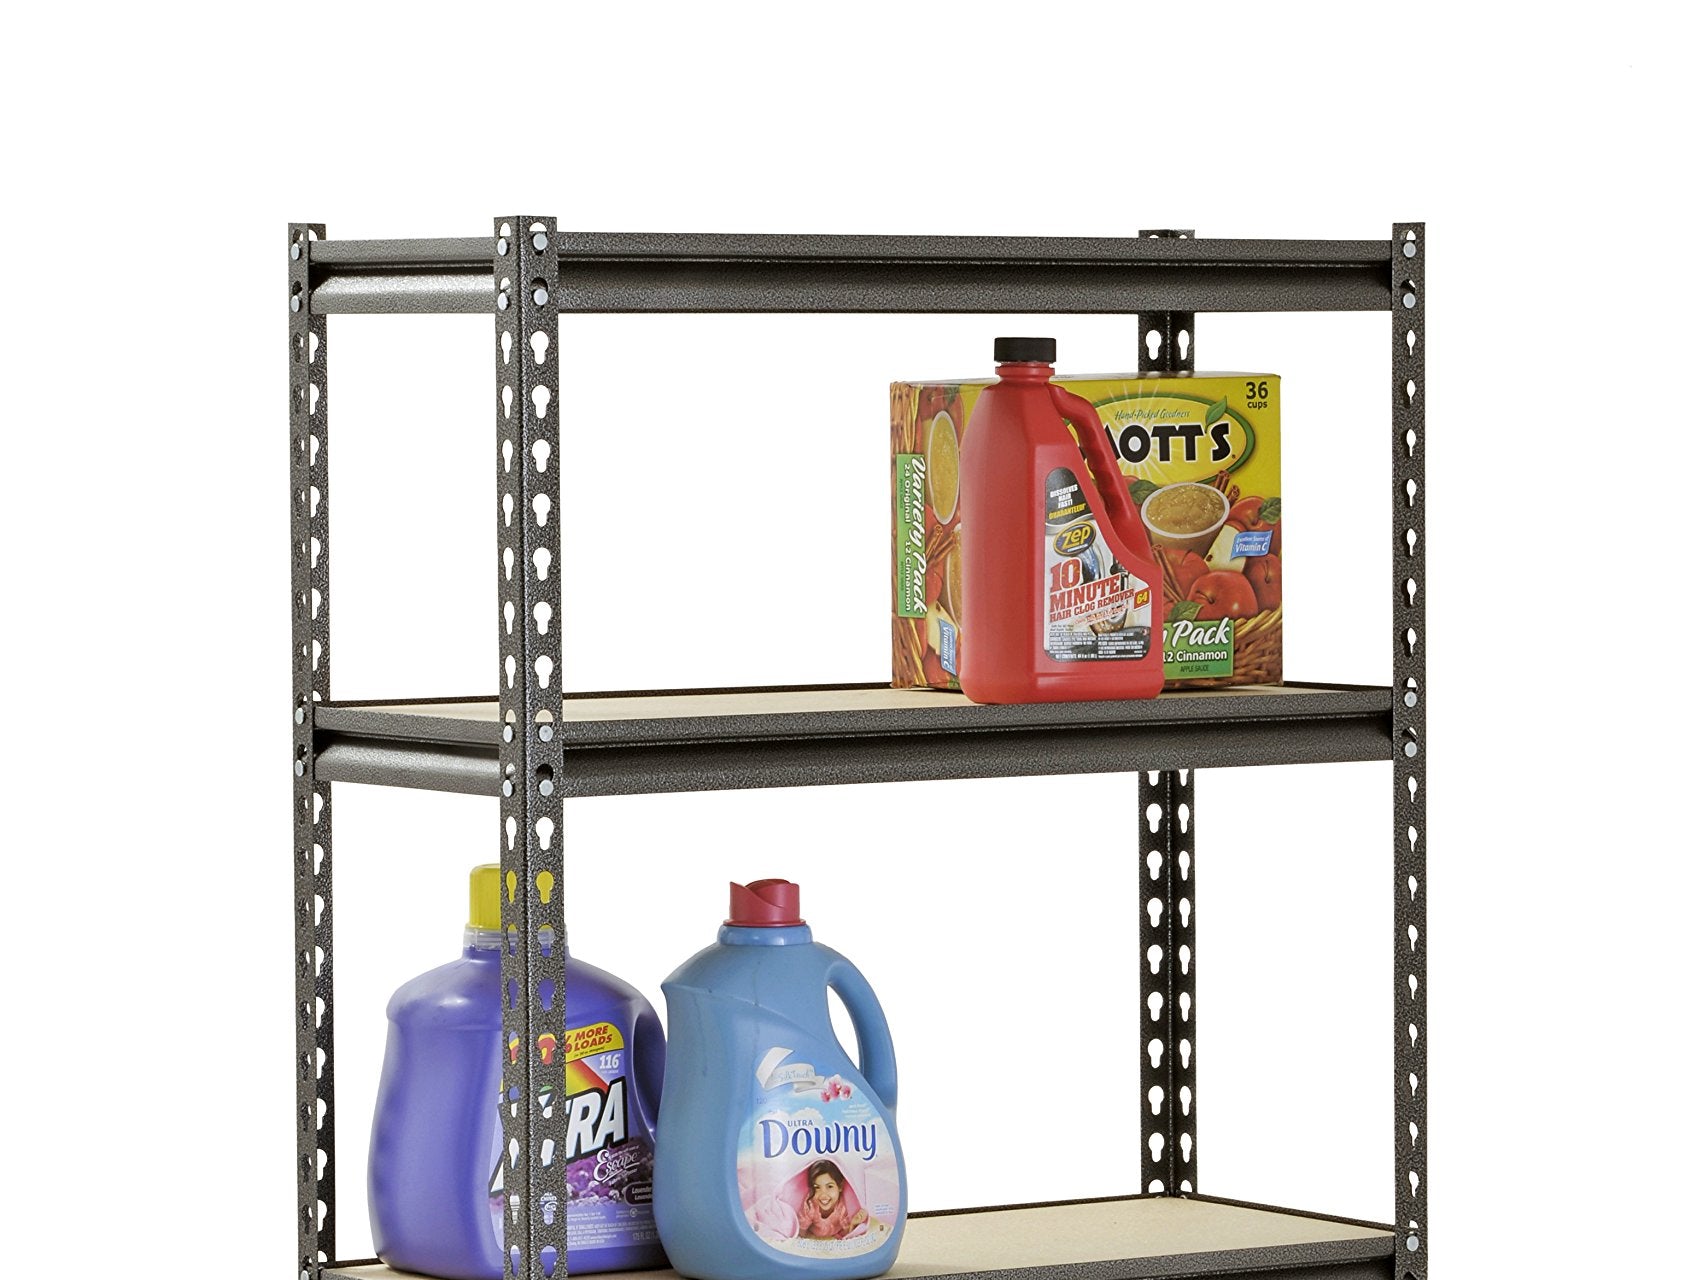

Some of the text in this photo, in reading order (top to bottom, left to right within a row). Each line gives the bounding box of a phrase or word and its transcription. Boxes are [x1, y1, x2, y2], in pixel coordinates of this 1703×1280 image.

[1245, 381, 1269, 400] 36
[1247, 401, 1268, 410] cups
[1115, 408, 1191, 420] Hand-Picked Goodness
[1104, 422, 1232, 463] OTT'S
[904, 464, 911, 477] 24
[911, 457, 928, 614] Variety Pack
[905, 541, 911, 554] 12
[1235, 541, 1267, 553] Vitamin C
[1050, 558, 1082, 593] 10
[1050, 574, 1120, 613] MINUTE
[1136, 592, 1148, 605] 64
[1050, 609, 1072, 622] HAIR
[1074, 601, 1096, 616] CLOG
[1097, 588, 1135, 608] REMOVER
[1172, 617, 1230, 647] Pack
[1176, 651, 1228, 662] Cinnamon
[1180, 664, 1209, 673] APPLE SAUCE
[575, 1025, 609, 1041] MORE
[575, 1034, 613, 1051] LOADS
[600, 1055, 620, 1070] 116
[787, 1119, 814, 1127] ULTRA
[759, 1119, 877, 1161] Downy
[593, 1149, 639, 1182] Escape
